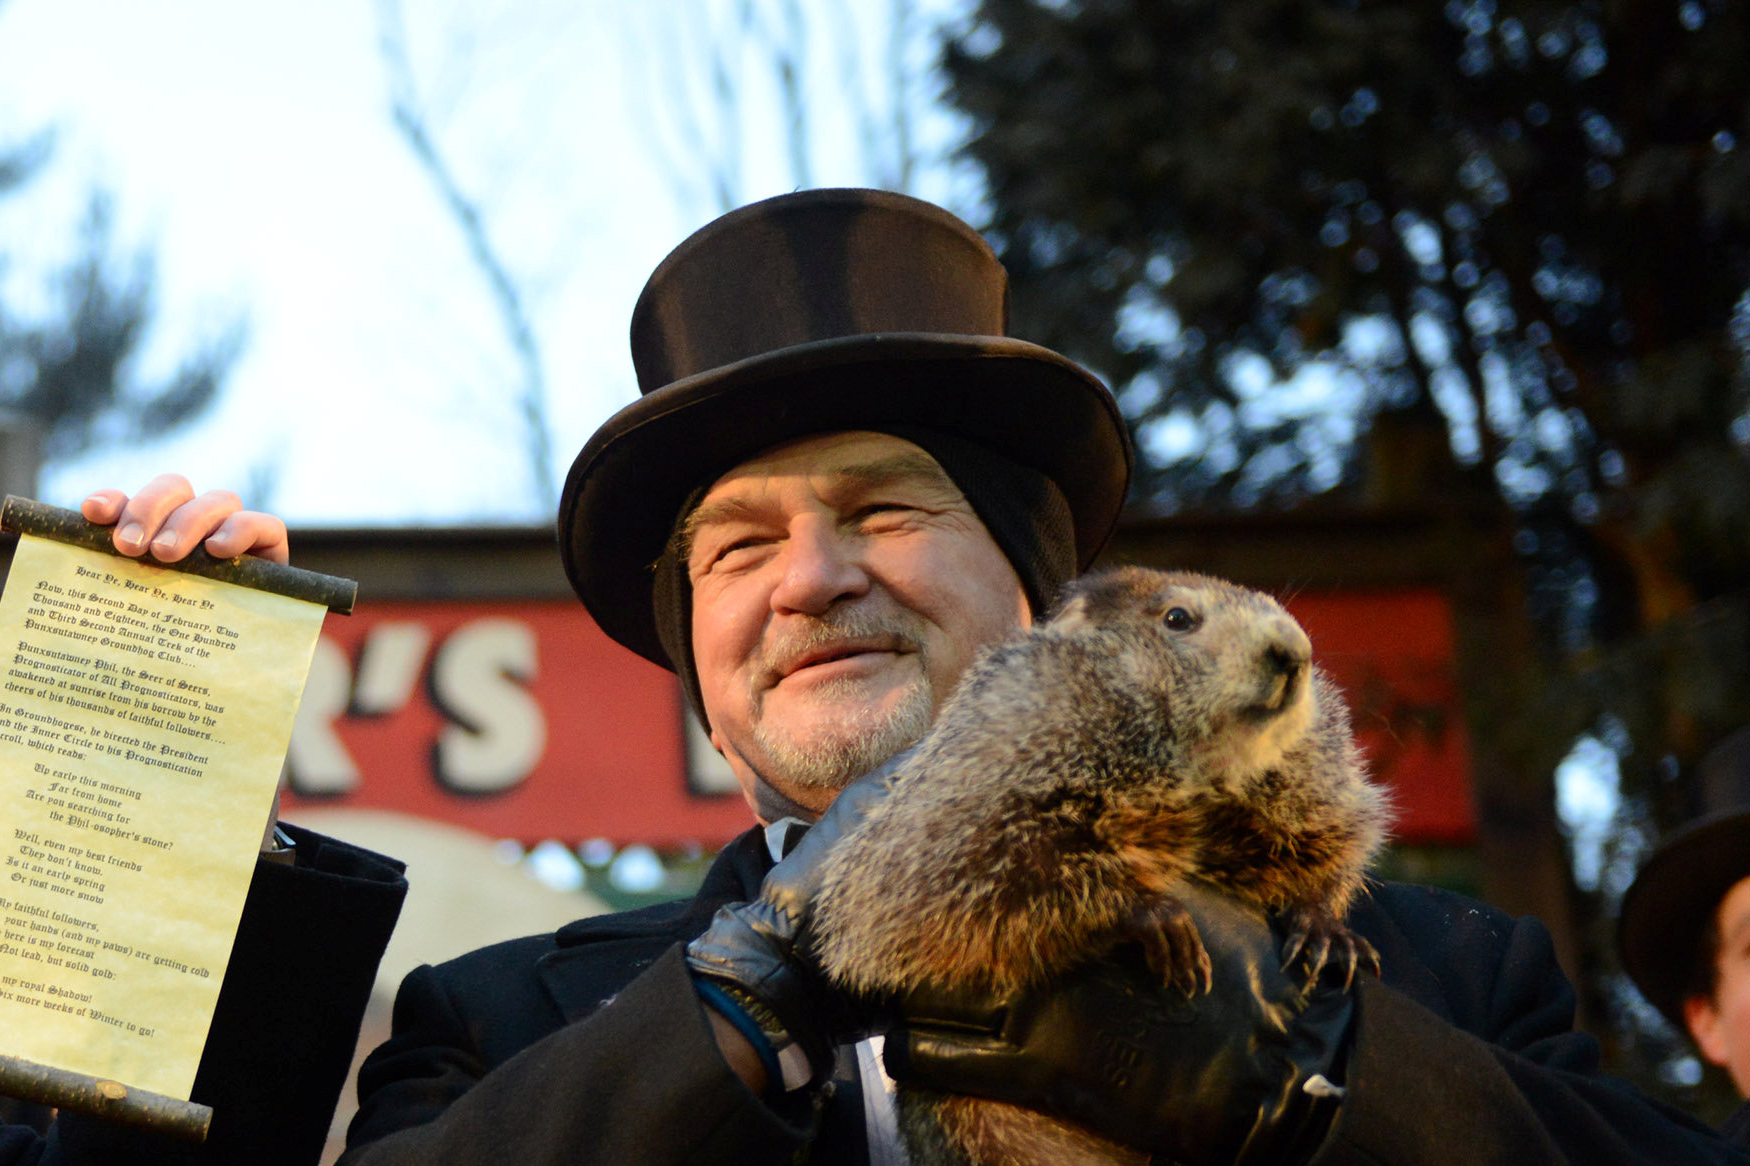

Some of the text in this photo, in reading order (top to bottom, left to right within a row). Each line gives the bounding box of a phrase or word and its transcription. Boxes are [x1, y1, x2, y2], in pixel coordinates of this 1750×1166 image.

[75, 566, 214, 609] Hear Ye, Hear Ye, Hear Ye
[33, 593, 236, 650] Thousand and Eighteen, the One Hundred
[35, 581, 64, 595] Now,
[68, 589, 86, 599] this
[88, 593, 124, 609] Second
[127, 603, 148, 616] Day
[161, 615, 211, 632] February,
[216, 626, 239, 638] Two
[24, 618, 98, 644] Punxsutawney
[100, 637, 154, 658] Groundhog
[28, 608, 45, 616] and
[49, 610, 76, 624] Third
[79, 618, 115, 633] Second
[118, 627, 154, 643] Annual
[158, 638, 181, 651] Trek
[196, 649, 210, 658] the
[13, 654, 86, 678] Prognosticator
[101, 675, 117, 686] All
[120, 679, 200, 709] Prognosticators,
[205, 702, 224, 713] was
[17, 641, 210, 697] Punxsutawney Phil, the Seer of Seers,
[5, 682, 35, 695] cheers
[37, 690, 47, 698] of
[49, 691, 64, 703] his
[66, 697, 115, 715] thousands
[117, 710, 127, 719] of
[129, 712, 164, 728] faithful
[8, 669, 55, 685] awakened
[70, 684, 106, 698] sunrise
[109, 692, 131, 705] from
[134, 698, 149, 709] his
[189, 712, 200, 723] by
[202, 716, 216, 727] the
[14, 708, 86, 734] Groundhogese,
[90, 727, 101, 736] he
[104, 730, 140, 746] directed
[142, 741, 156, 751] the
[159, 744, 208, 764] President
[14, 722, 28, 731] the
[31, 725, 60, 739] Inner
[64, 734, 92, 748] Circle
[95, 743, 104, 751] to
[107, 745, 122, 756] his
[124, 750, 202, 777] Prognostication
[28, 739, 54, 753] which
[57, 748, 86, 760] reads:
[34, 763, 142, 800] Up early this morning
[48, 783, 122, 808] Far from home
[26, 790, 130, 824] Are you searching for
[15, 829, 142, 872] Well, even my best friends
[50, 811, 64, 821] the
[142, 837, 173, 850] stone?
[6, 856, 19, 866] Is
[46, 870, 71, 881] early
[74, 877, 105, 892] spring
[20, 846, 45, 860] They
[47, 853, 72, 867] don't
[11, 872, 104, 904] Or just more snow
[14, 902, 49, 918] faithful
[52, 912, 98, 932] followers,
[4, 929, 24, 941] here
[39, 940, 54, 950] my
[57, 942, 94, 959] forecast
[5, 917, 209, 978] your hands (and my paws) are getting cold
[21, 949, 43, 962] lead,
[47, 955, 63, 966] but
[65, 961, 89, 972] solid
[92, 968, 116, 980] gold:
[2, 976, 17, 986] my
[20, 980, 45, 992] royal
[47, 985, 92, 1003] Shadow!
[16, 995, 40, 1006] more
[44, 1000, 74, 1013] weeks
[90, 1010, 123, 1027] Winter
[126, 1022, 136, 1031] to
[139, 1027, 154, 1037] go!
